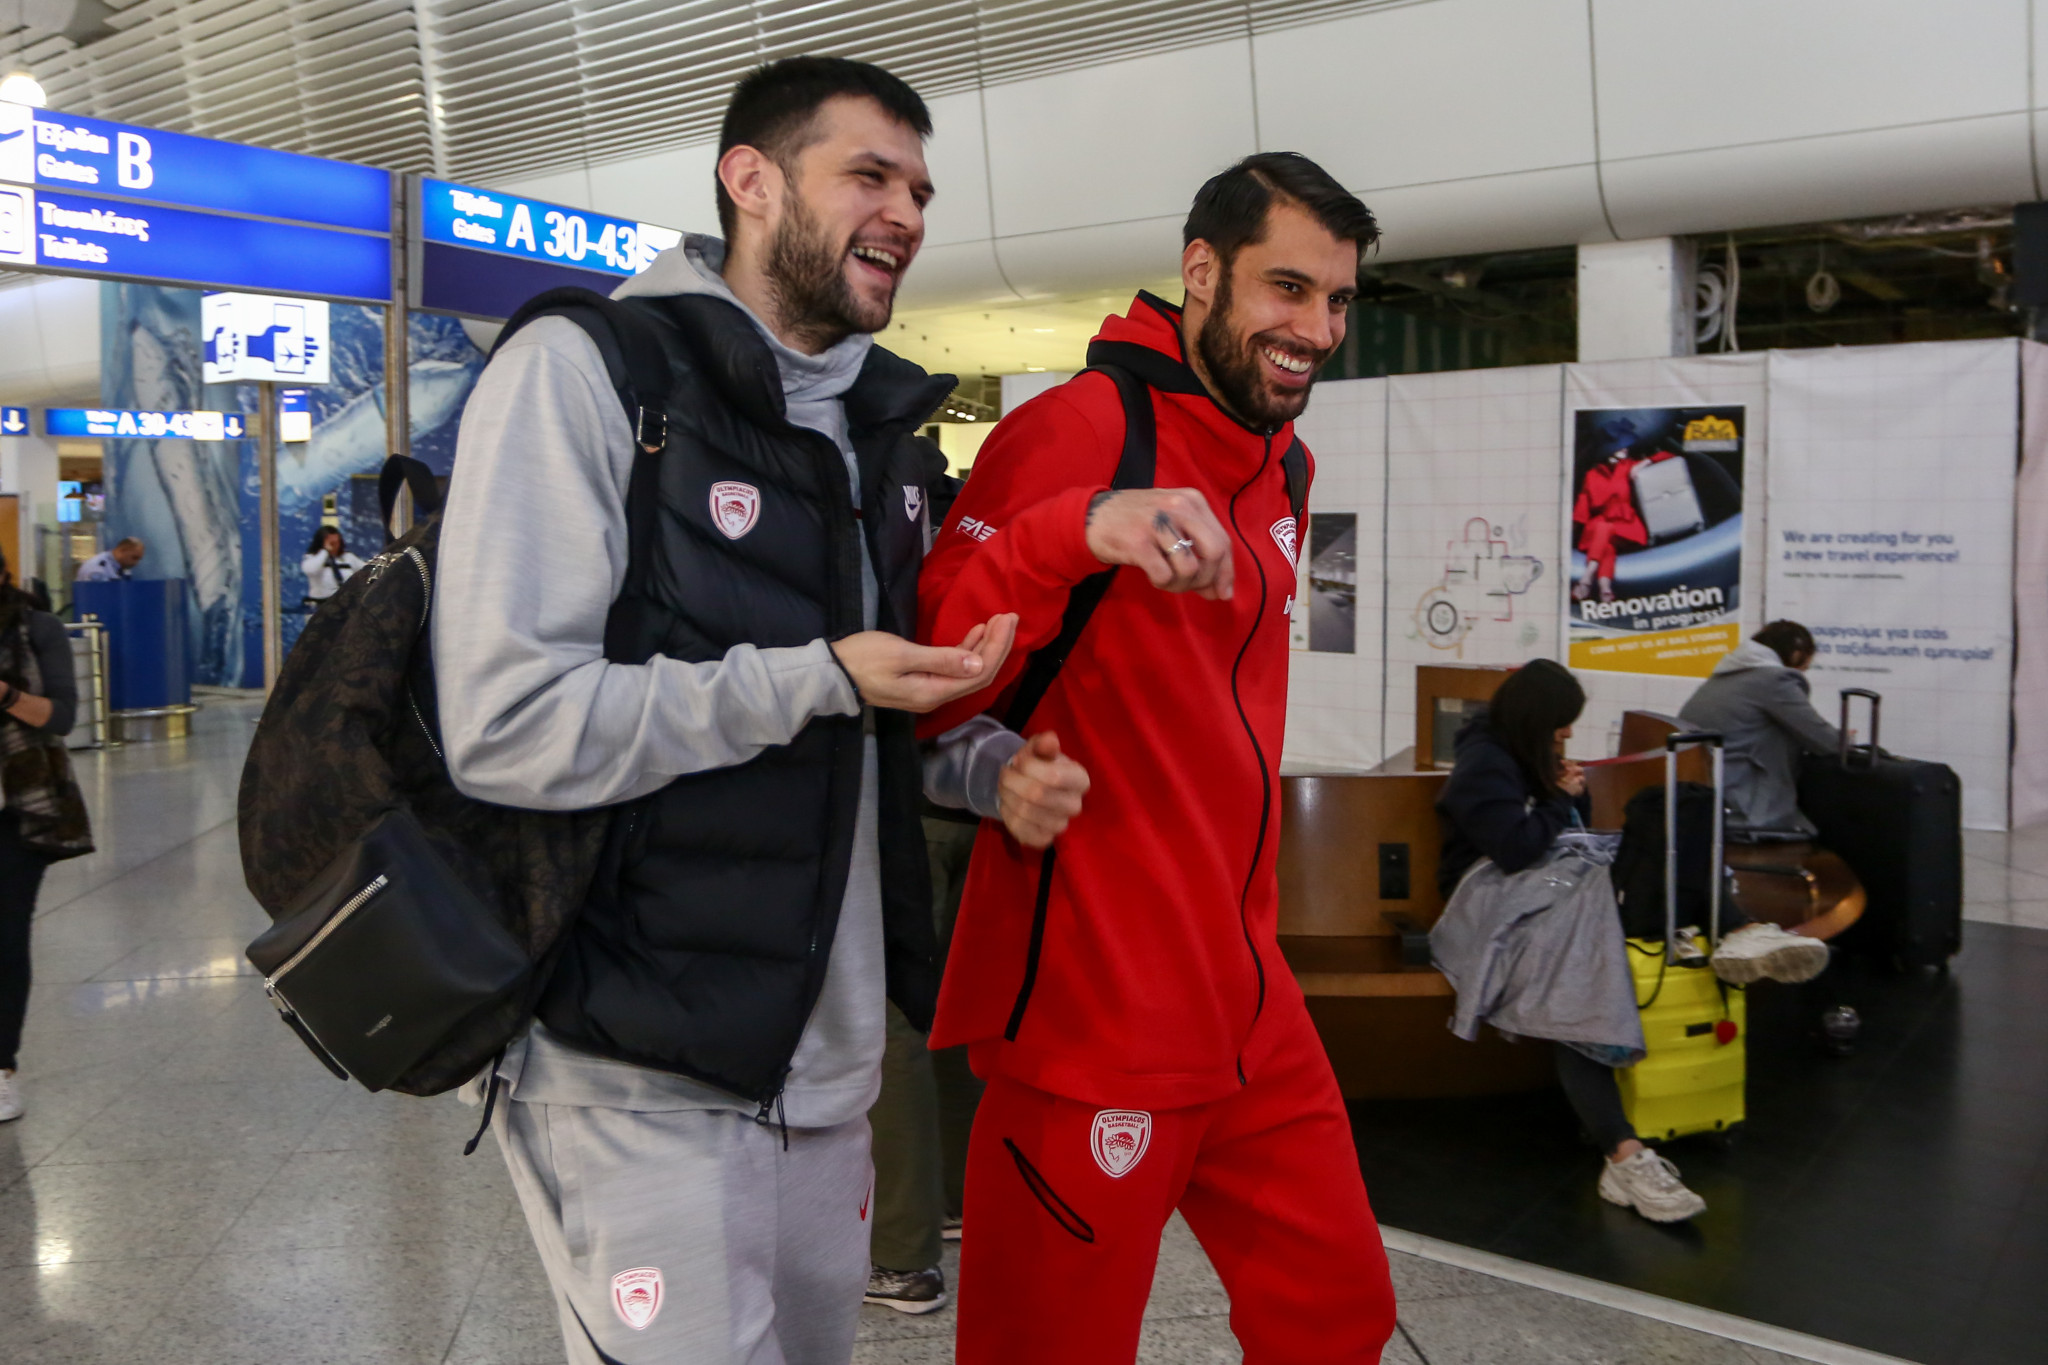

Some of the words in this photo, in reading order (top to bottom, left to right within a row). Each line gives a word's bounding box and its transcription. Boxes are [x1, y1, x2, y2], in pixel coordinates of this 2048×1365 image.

[118, 132, 153, 189] B
[39, 234, 108, 263] Toilets
[506, 204, 536, 252] A
[544, 211, 637, 270] 30-43
[1782, 531, 1806, 544] We
[1809, 532, 1832, 544] are
[1837, 530, 1898, 547] creating
[1901, 530, 1923, 544] for
[1927, 533, 1954, 547] you
[1783, 550, 1792, 561] a
[1795, 550, 1822, 561] new
[1827, 550, 1869, 562] travel
[1580, 584, 1724, 621] Renovation
[1632, 616, 1649, 630] in
[1652, 606, 1726, 631] progress!
[1101, 1115, 1145, 1124] OLYMPIACOS
